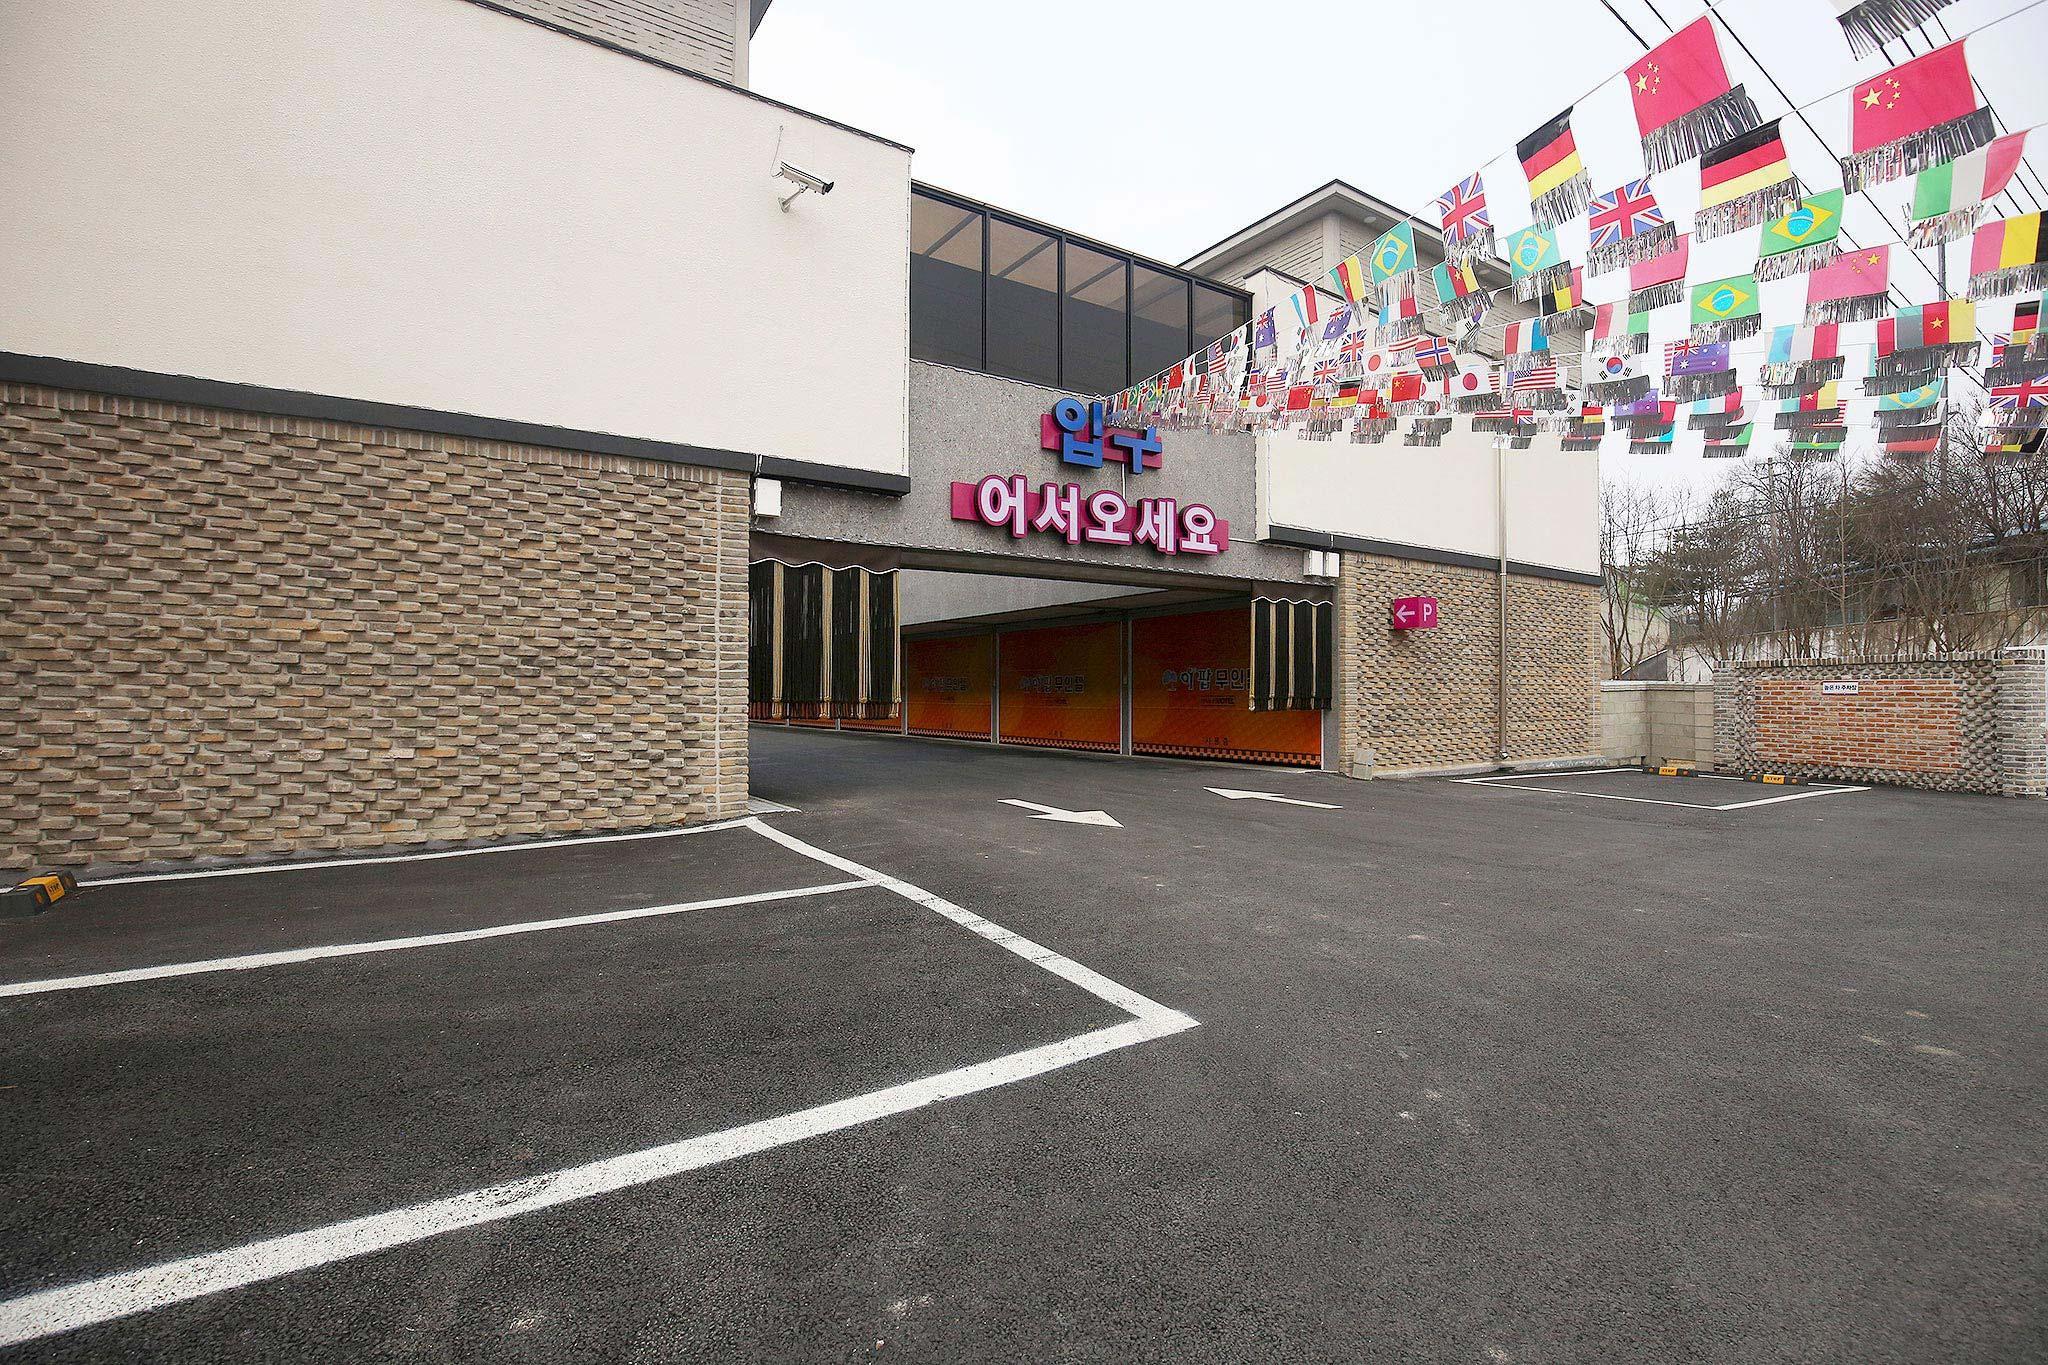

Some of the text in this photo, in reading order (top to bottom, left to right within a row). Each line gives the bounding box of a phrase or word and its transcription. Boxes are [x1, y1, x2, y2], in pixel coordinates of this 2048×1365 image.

[1052, 397, 1162, 474] 입구
[975, 474, 1220, 556] 어서오세요
[1423, 603, 1432, 622] P
